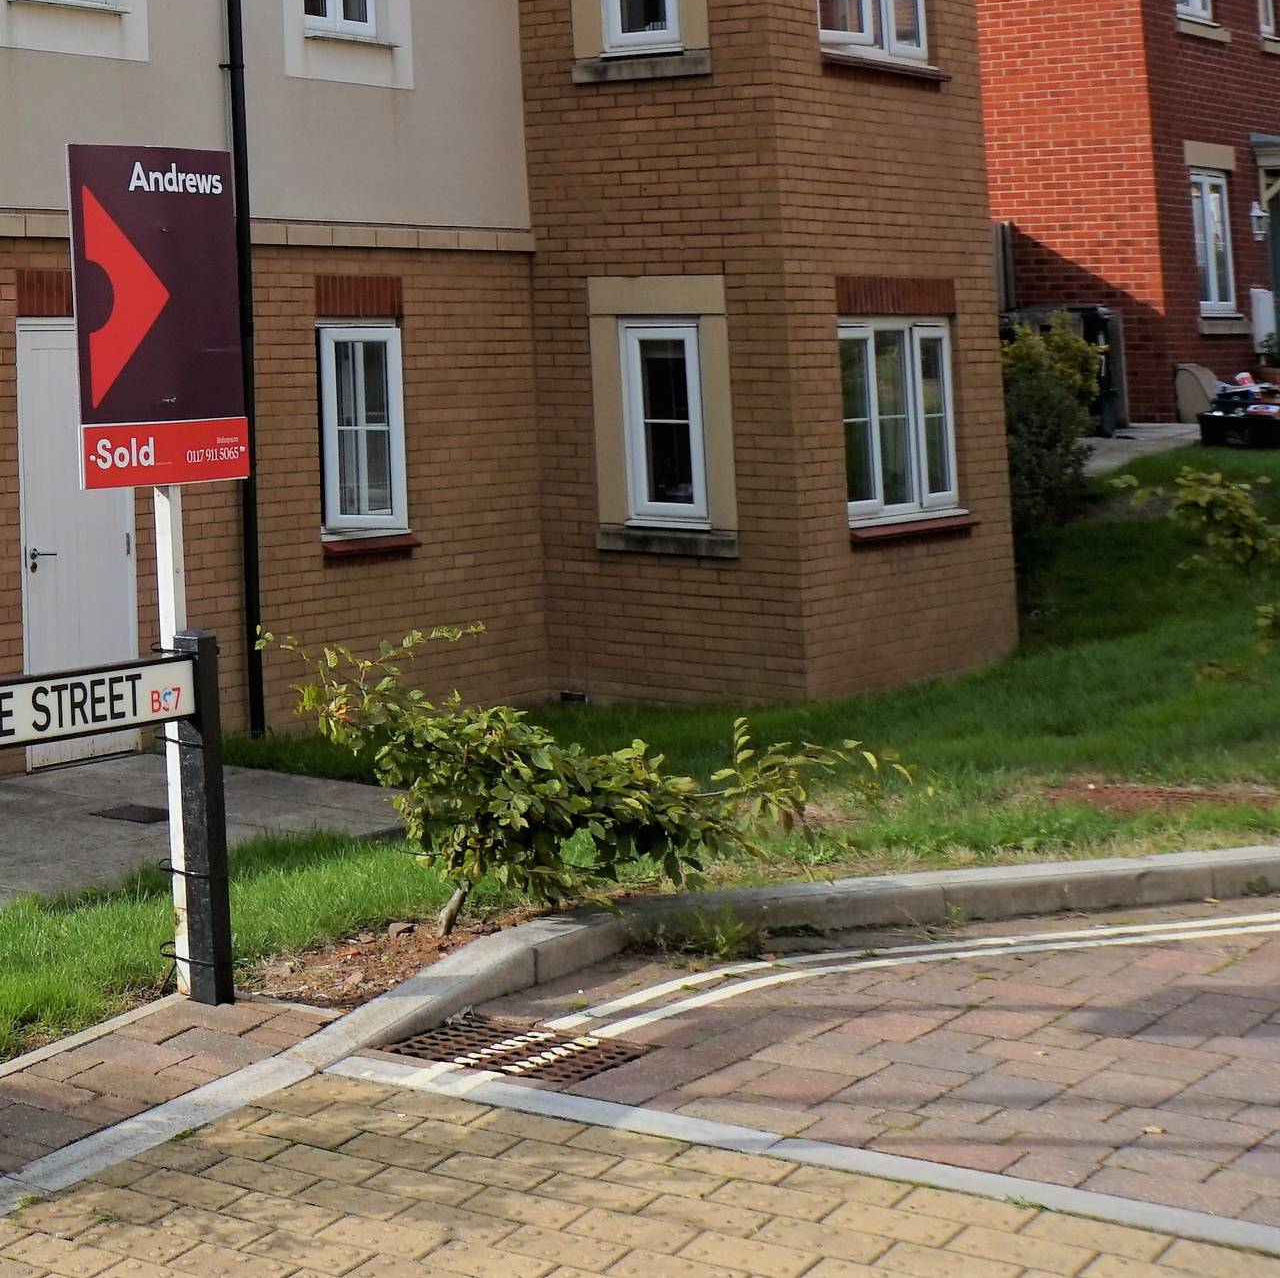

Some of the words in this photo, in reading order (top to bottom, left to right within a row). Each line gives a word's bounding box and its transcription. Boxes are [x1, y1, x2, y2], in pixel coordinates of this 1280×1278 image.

[128, 161, 223, 195] Andrews
[96, 436, 155, 470] Sold
[186, 449, 205, 463] 0117
[205, 448, 219, 462] 911
[219, 446, 239, 461] 5065
[31, 673, 142, 732] STREET
[150, 686, 181, 713] BS7
